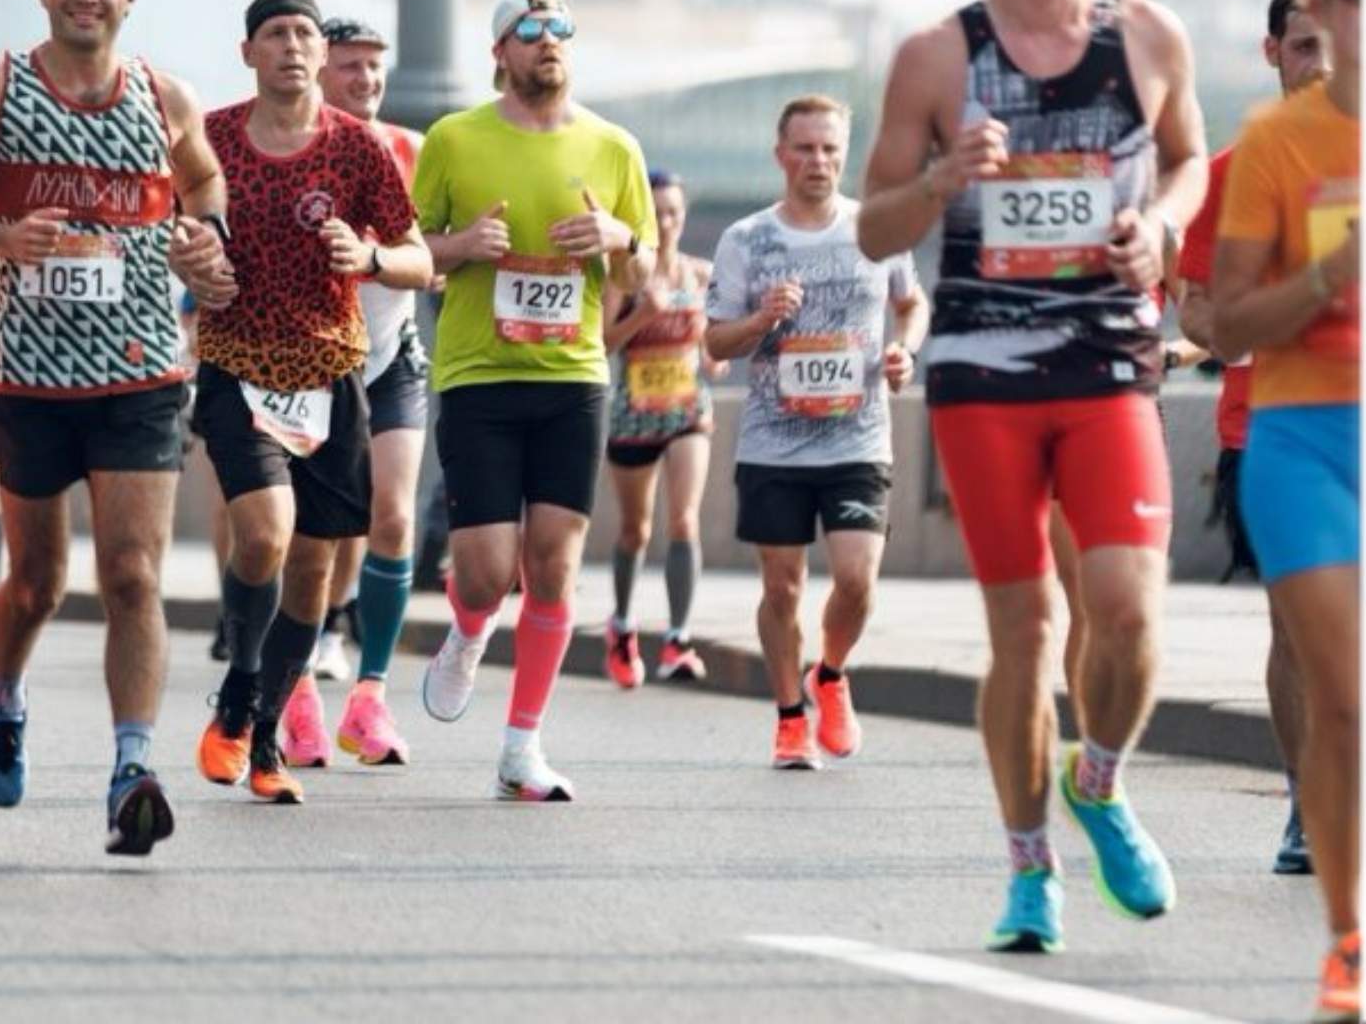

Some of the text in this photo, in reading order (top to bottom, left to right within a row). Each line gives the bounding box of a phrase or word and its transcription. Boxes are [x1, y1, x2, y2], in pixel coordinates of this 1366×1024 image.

[1001, 190, 1093, 227] 3258
[36, 265, 104, 297] 1051
[512, 279, 574, 309] 1292
[794, 359, 853, 384] 1094
